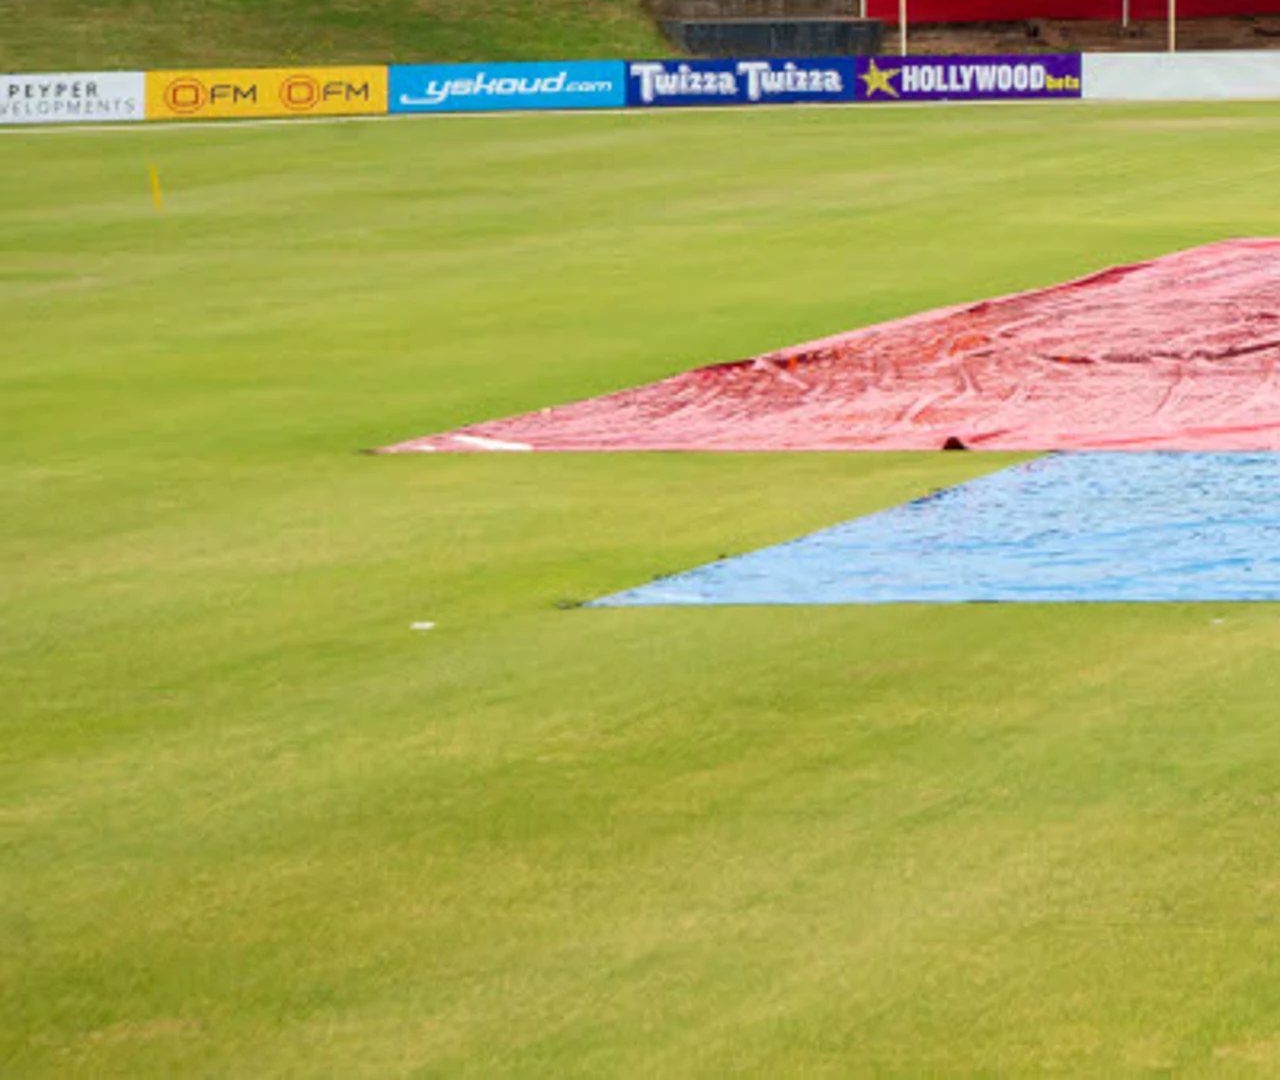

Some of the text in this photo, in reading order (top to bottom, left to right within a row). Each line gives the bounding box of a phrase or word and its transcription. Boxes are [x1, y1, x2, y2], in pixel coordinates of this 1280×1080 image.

[9, 81, 99, 98] PEYPER
[400, 71, 613, 104] yskoud.com
[630, 61, 843, 102] Twizza Twizza
